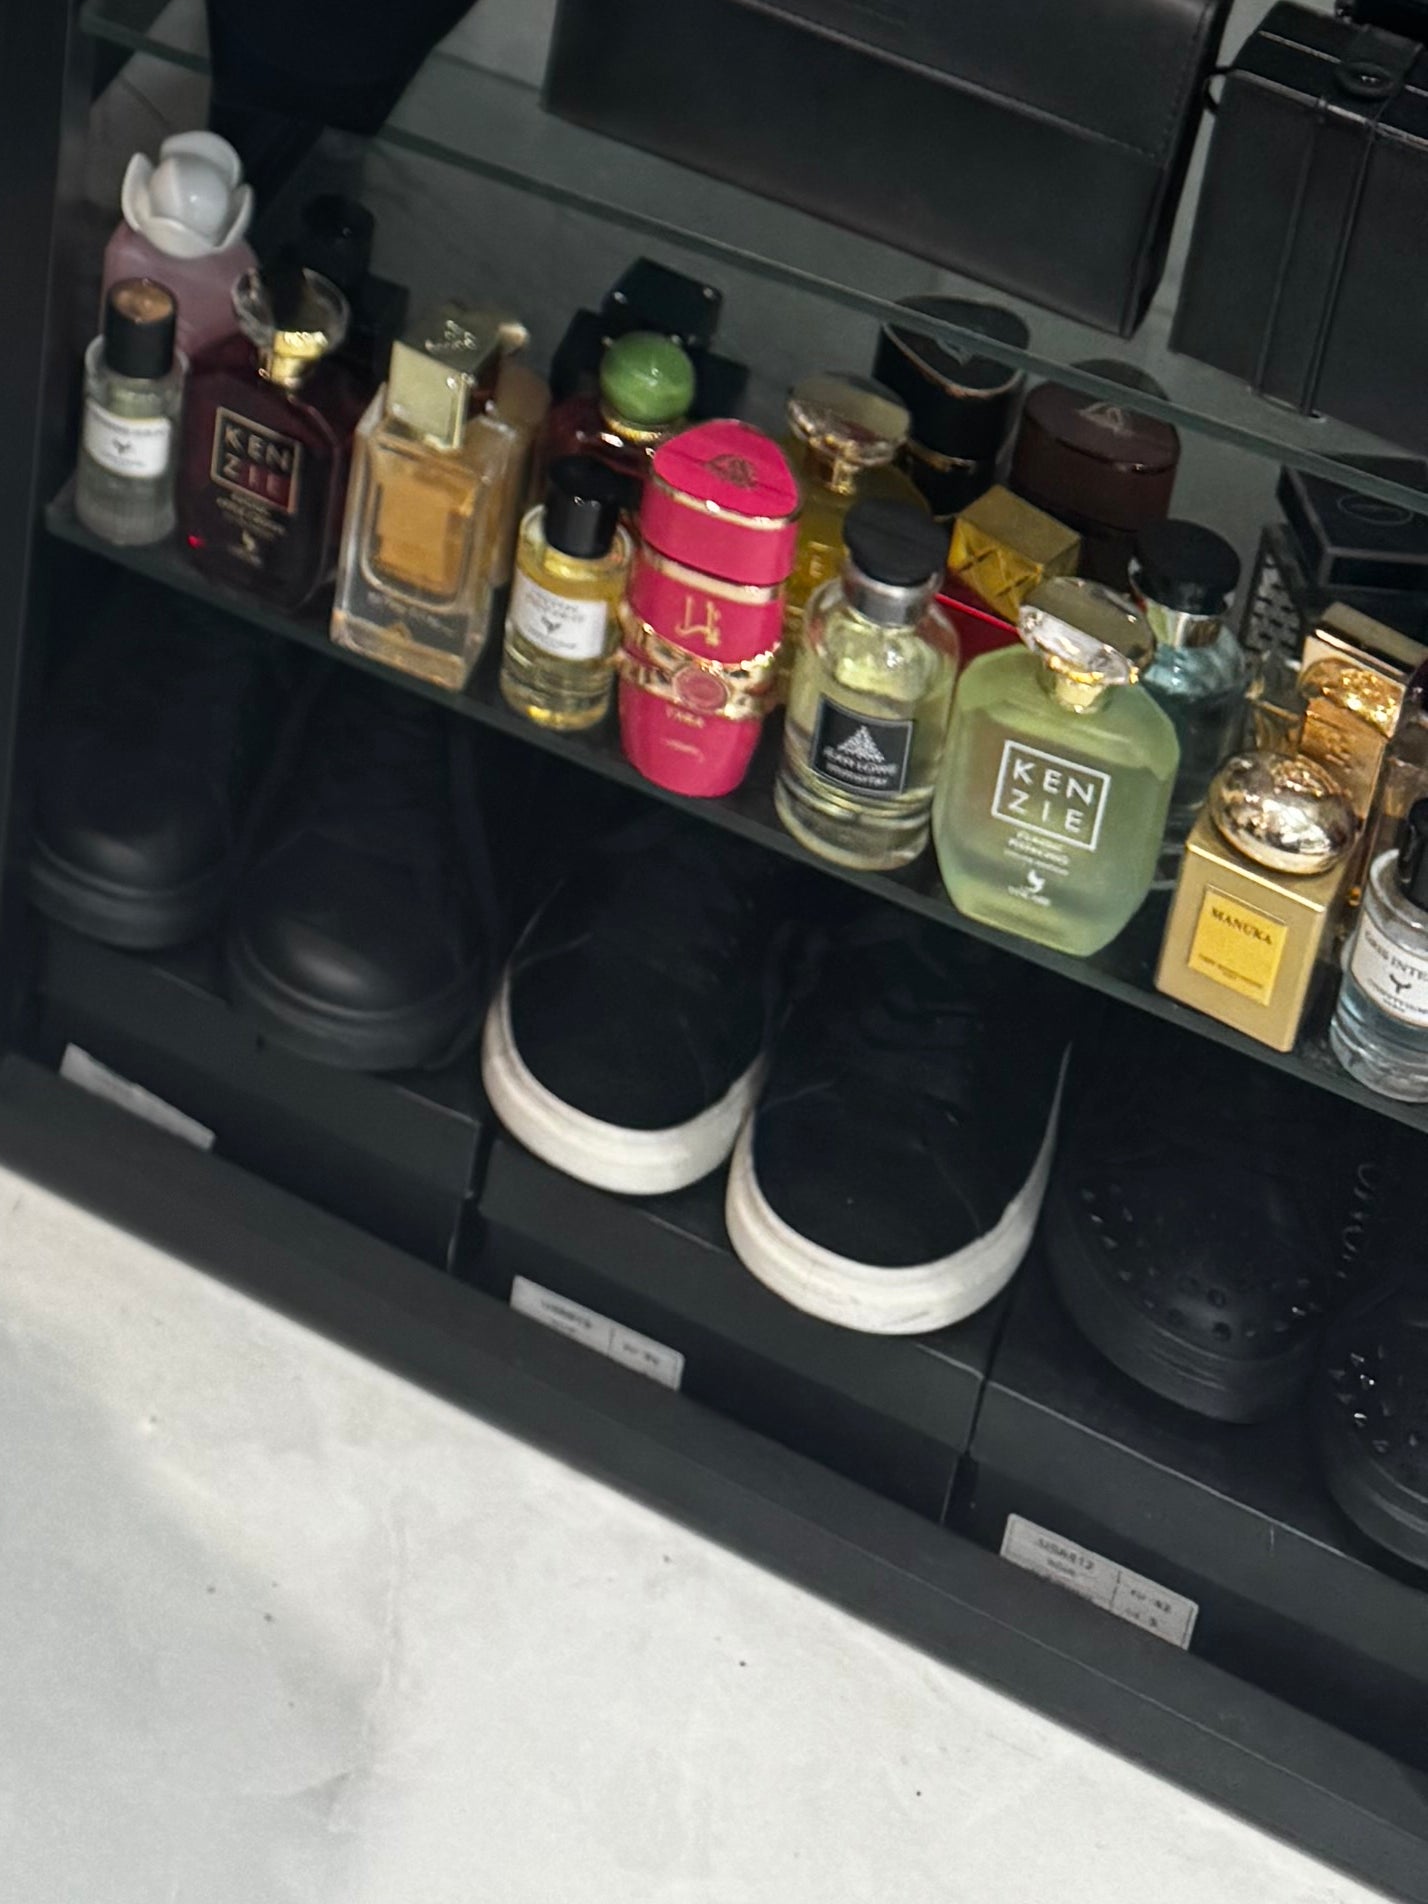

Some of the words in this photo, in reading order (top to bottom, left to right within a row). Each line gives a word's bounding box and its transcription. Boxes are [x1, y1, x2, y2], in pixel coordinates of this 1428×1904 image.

[224, 425, 290, 473] KEN
[1012, 758, 1095, 807] KEN
[1007, 788, 1085, 834] ZIE
